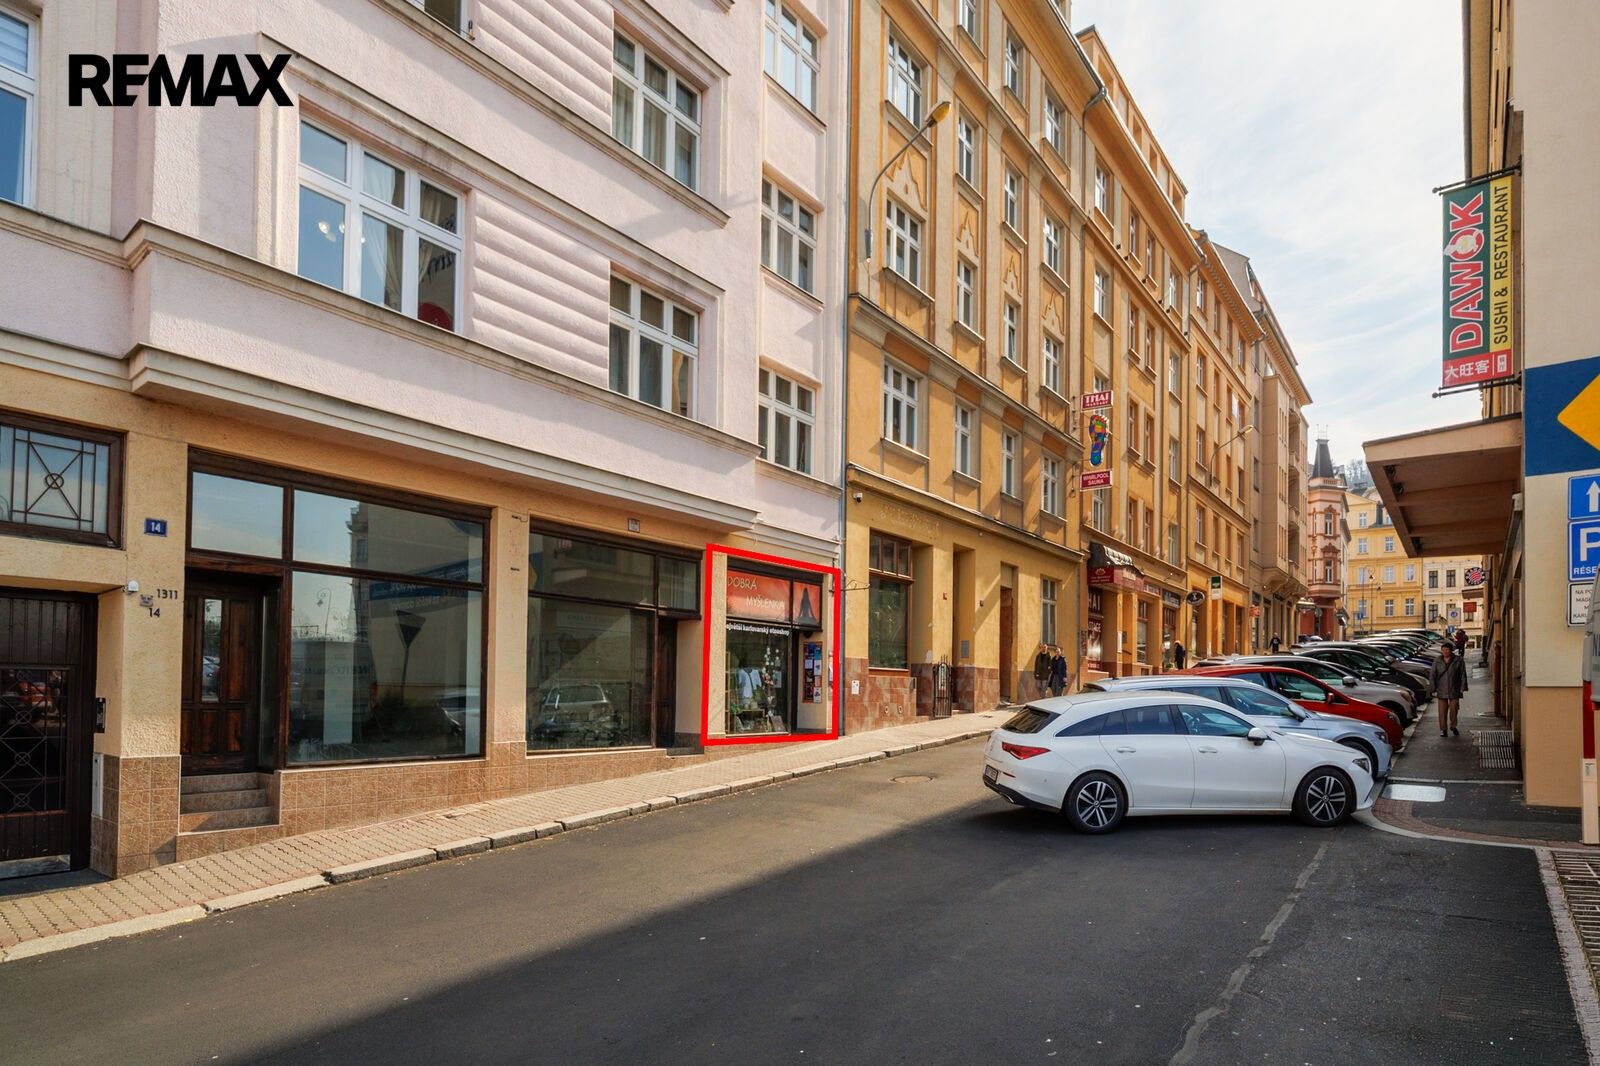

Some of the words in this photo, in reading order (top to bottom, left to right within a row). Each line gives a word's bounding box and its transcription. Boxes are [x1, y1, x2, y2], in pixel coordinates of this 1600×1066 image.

[1494, 185, 1508, 281] RESTAURANT
[1449, 191, 1485, 354] DAWOK
[1494, 286, 1508, 297] &
[1494, 299, 1508, 344] SUSHI
[1085, 392, 1109, 404] THAI
[1083, 473, 1109, 481] WHIRLPOOL
[151, 521, 162, 533] 14
[1580, 526, 1600, 562] P
[1573, 565, 1598, 576] RÉSE
[727, 576, 758, 590] DOBRÁ
[157, 588, 178, 600] 1311
[746, 593, 785, 609] MYŠLENKA
[149, 607, 160, 618] 14
